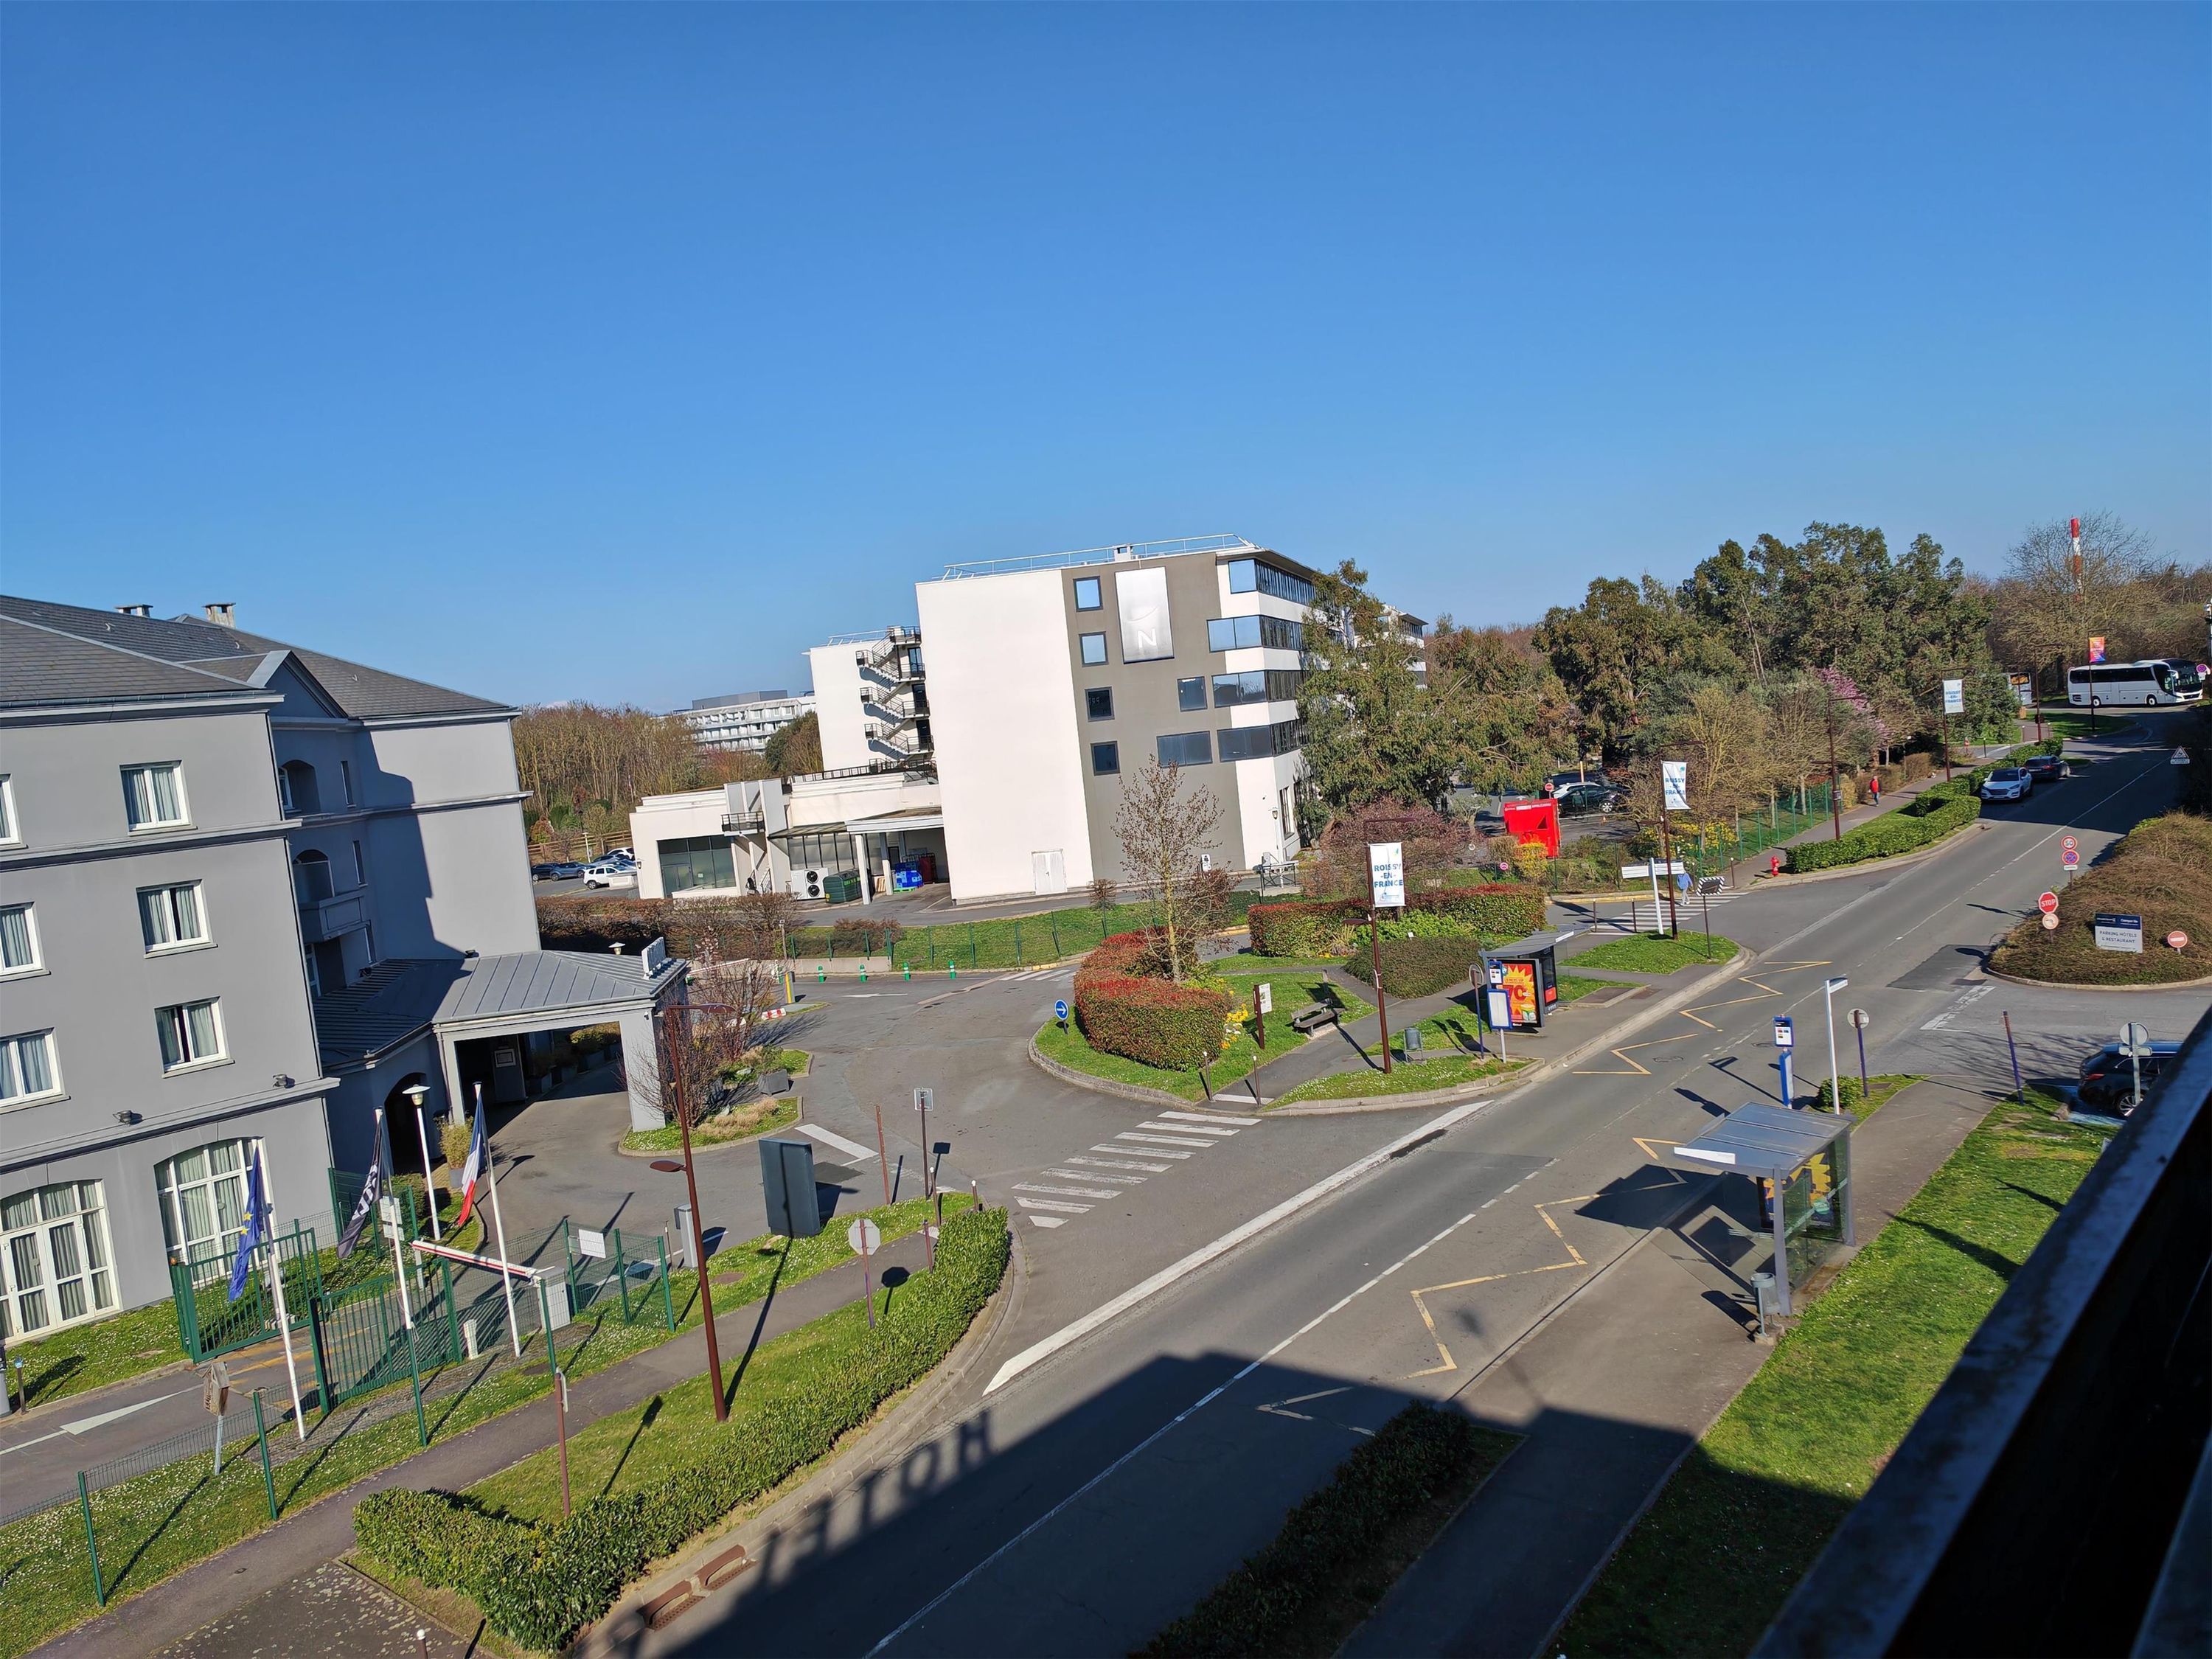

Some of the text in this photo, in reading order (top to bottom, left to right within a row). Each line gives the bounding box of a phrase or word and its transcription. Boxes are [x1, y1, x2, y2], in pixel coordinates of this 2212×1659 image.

[1138, 629, 1157, 648] N
[1374, 863, 1401, 872] ROISSY
[1374, 880, 1403, 888] FRANCE
[2041, 899, 2056, 907] STOP
